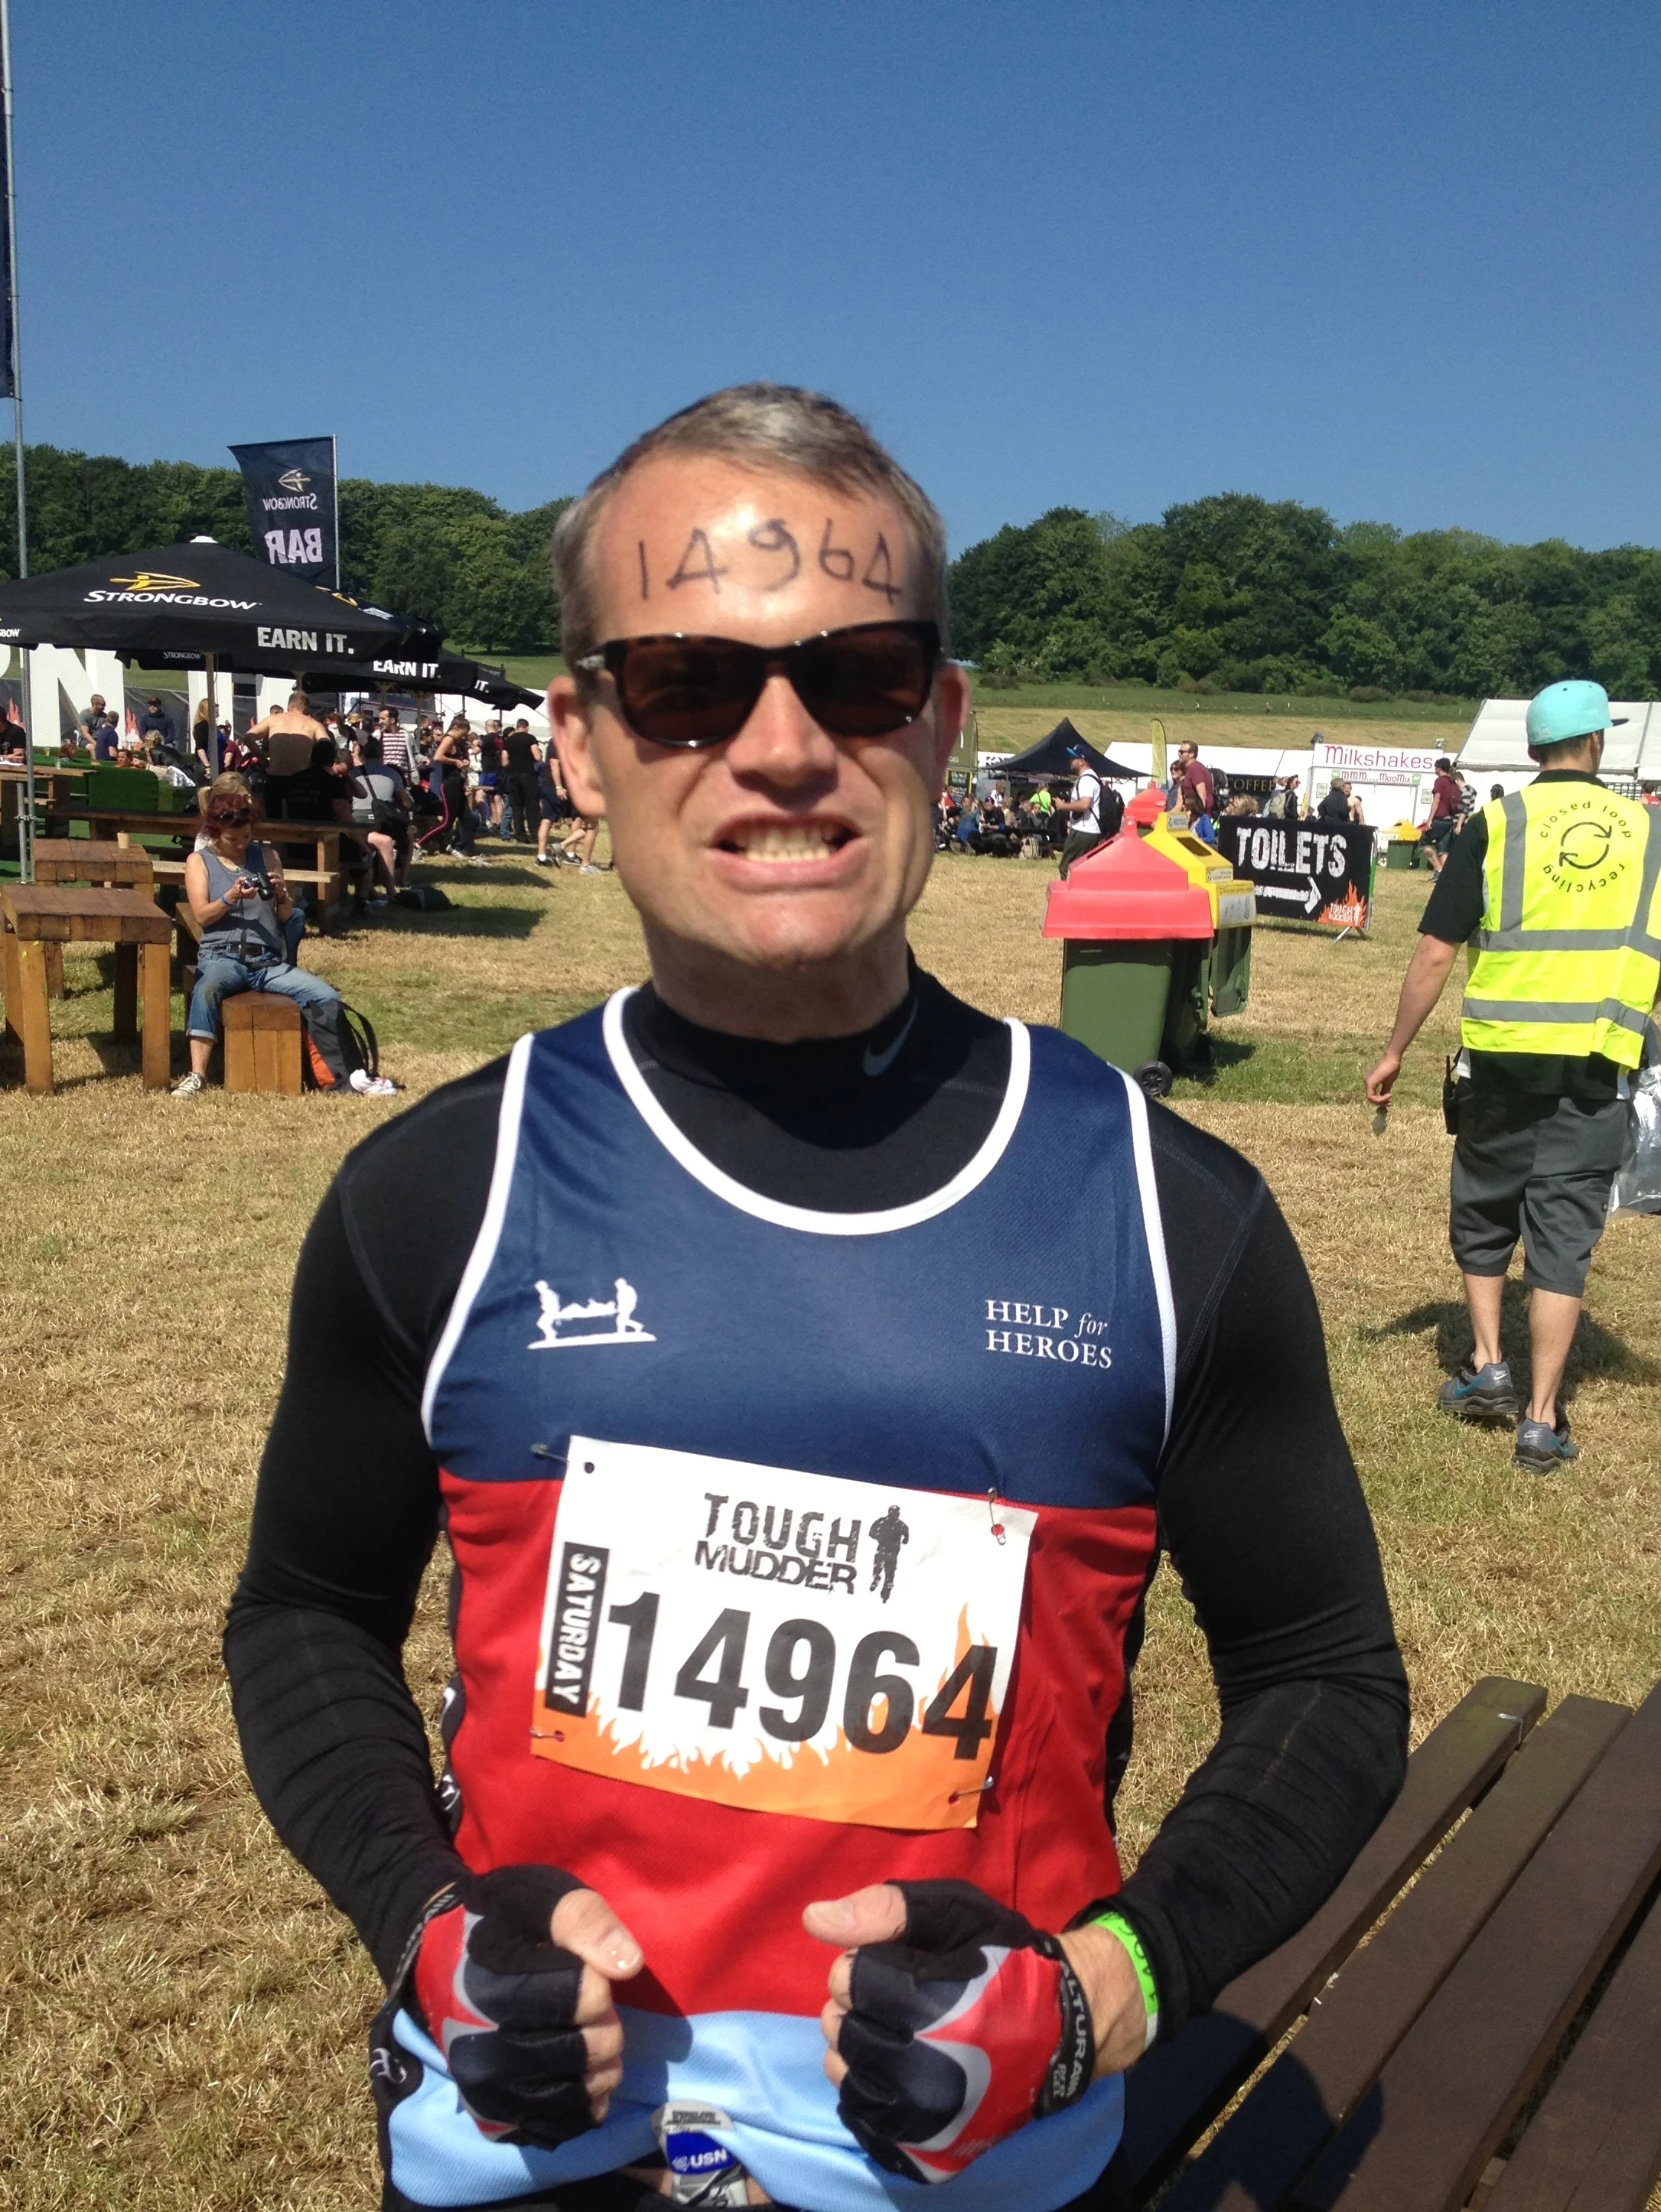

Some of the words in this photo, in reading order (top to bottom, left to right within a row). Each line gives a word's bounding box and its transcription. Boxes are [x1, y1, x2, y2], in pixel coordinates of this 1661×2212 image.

[638, 518, 901, 605] 14964
[83, 590, 259, 610] STRONGBOW
[163, 651, 201, 660] STRONGBOW
[257, 626, 318, 652] EARN
[325, 633, 355, 655] IT.
[373, 659, 417, 678] EARN
[422, 662, 441, 679] IT.
[474, 679, 490, 694] IT.
[1324, 745, 1433, 769] Milkshakes
[1540, 801, 1591, 838] closed
[1602, 805, 1631, 838] loop
[1236, 826, 1347, 878] TOILETS
[1542, 863, 1625, 893] recycling
[985, 1299, 1069, 1329] HELP
[1073, 1312, 1108, 1339] for
[985, 1329, 1112, 1369] HEROES
[704, 1492, 862, 1563] TOUGH
[694, 1540, 858, 1596] MUDDER
[552, 1551, 603, 1706] SATURDAY
[607, 1590, 998, 1761] 14964
[690, 2148, 728, 2168] USN
